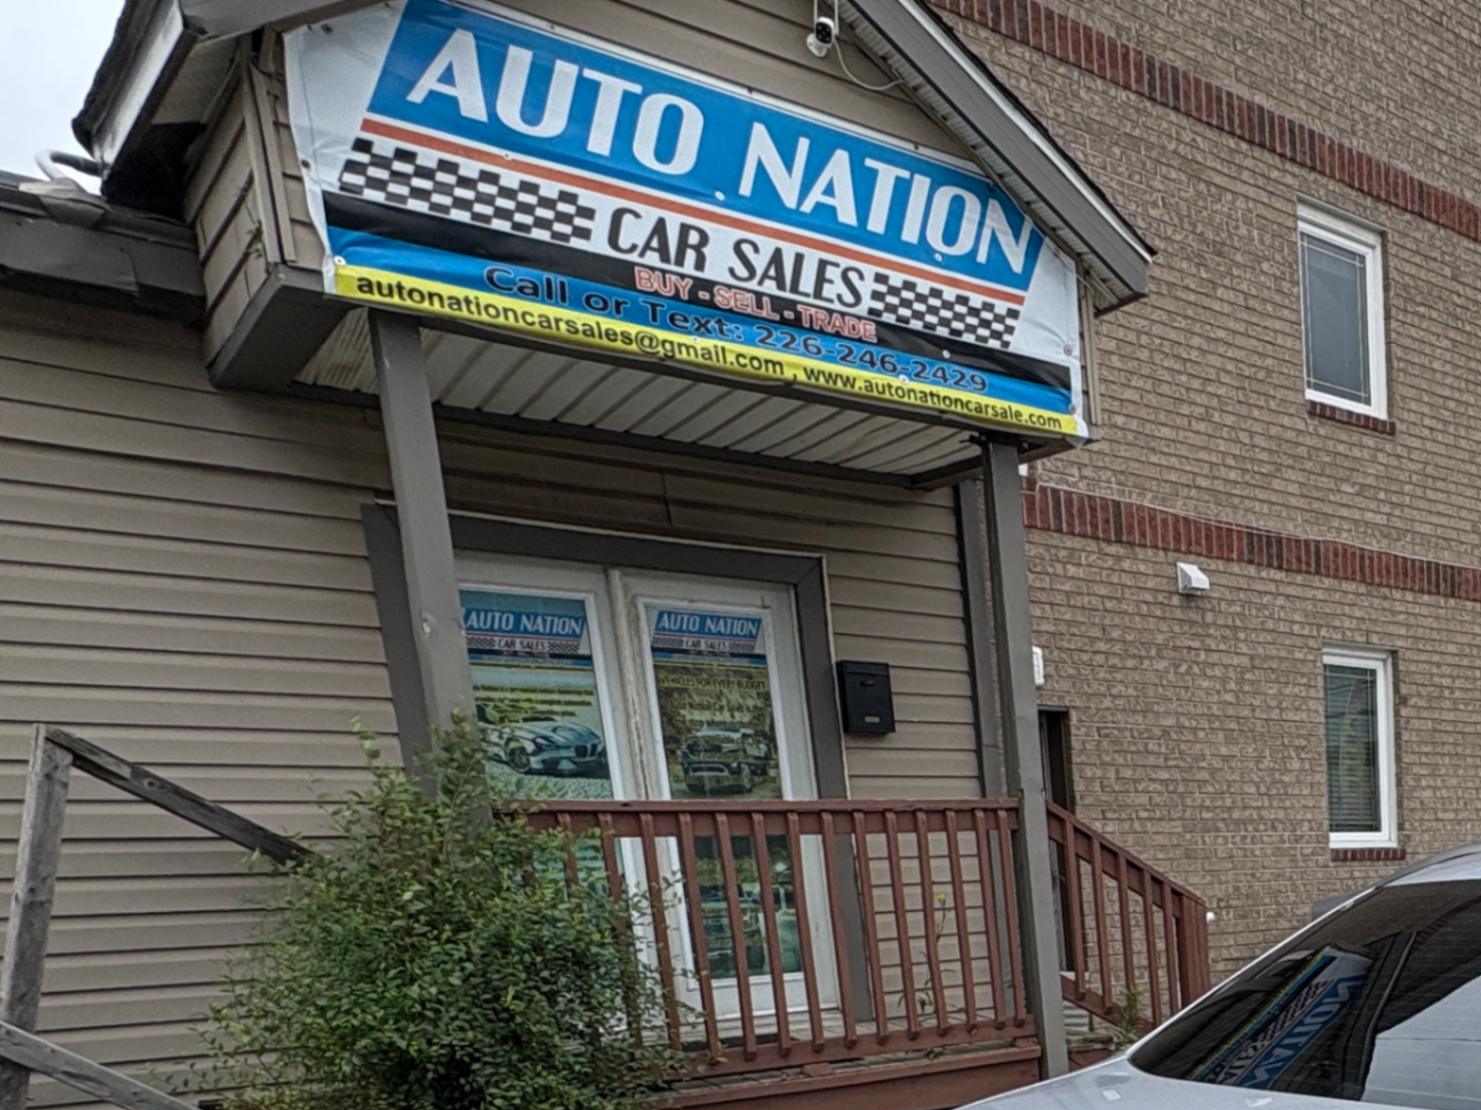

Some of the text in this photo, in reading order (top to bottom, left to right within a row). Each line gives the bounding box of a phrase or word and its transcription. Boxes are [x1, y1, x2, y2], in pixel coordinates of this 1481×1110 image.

[405, 27, 1035, 275] AUTO NATION
[606, 206, 866, 309] CAR SALES
[484, 265, 989, 392] Call or Text: 226-246-2429
[633, 265, 694, 300] BUY
[713, 285, 780, 321] SELL
[796, 304, 878, 344] TRADE
[356, 276, 785, 376] autonationcarsales@gmail.com
[802, 365, 1063, 431] www.autonationcarsale.com
[466, 610, 583, 635] AUTO NATION
[497, 638, 516, 649] CAR
[658, 612, 759, 636] AUTO NATION
